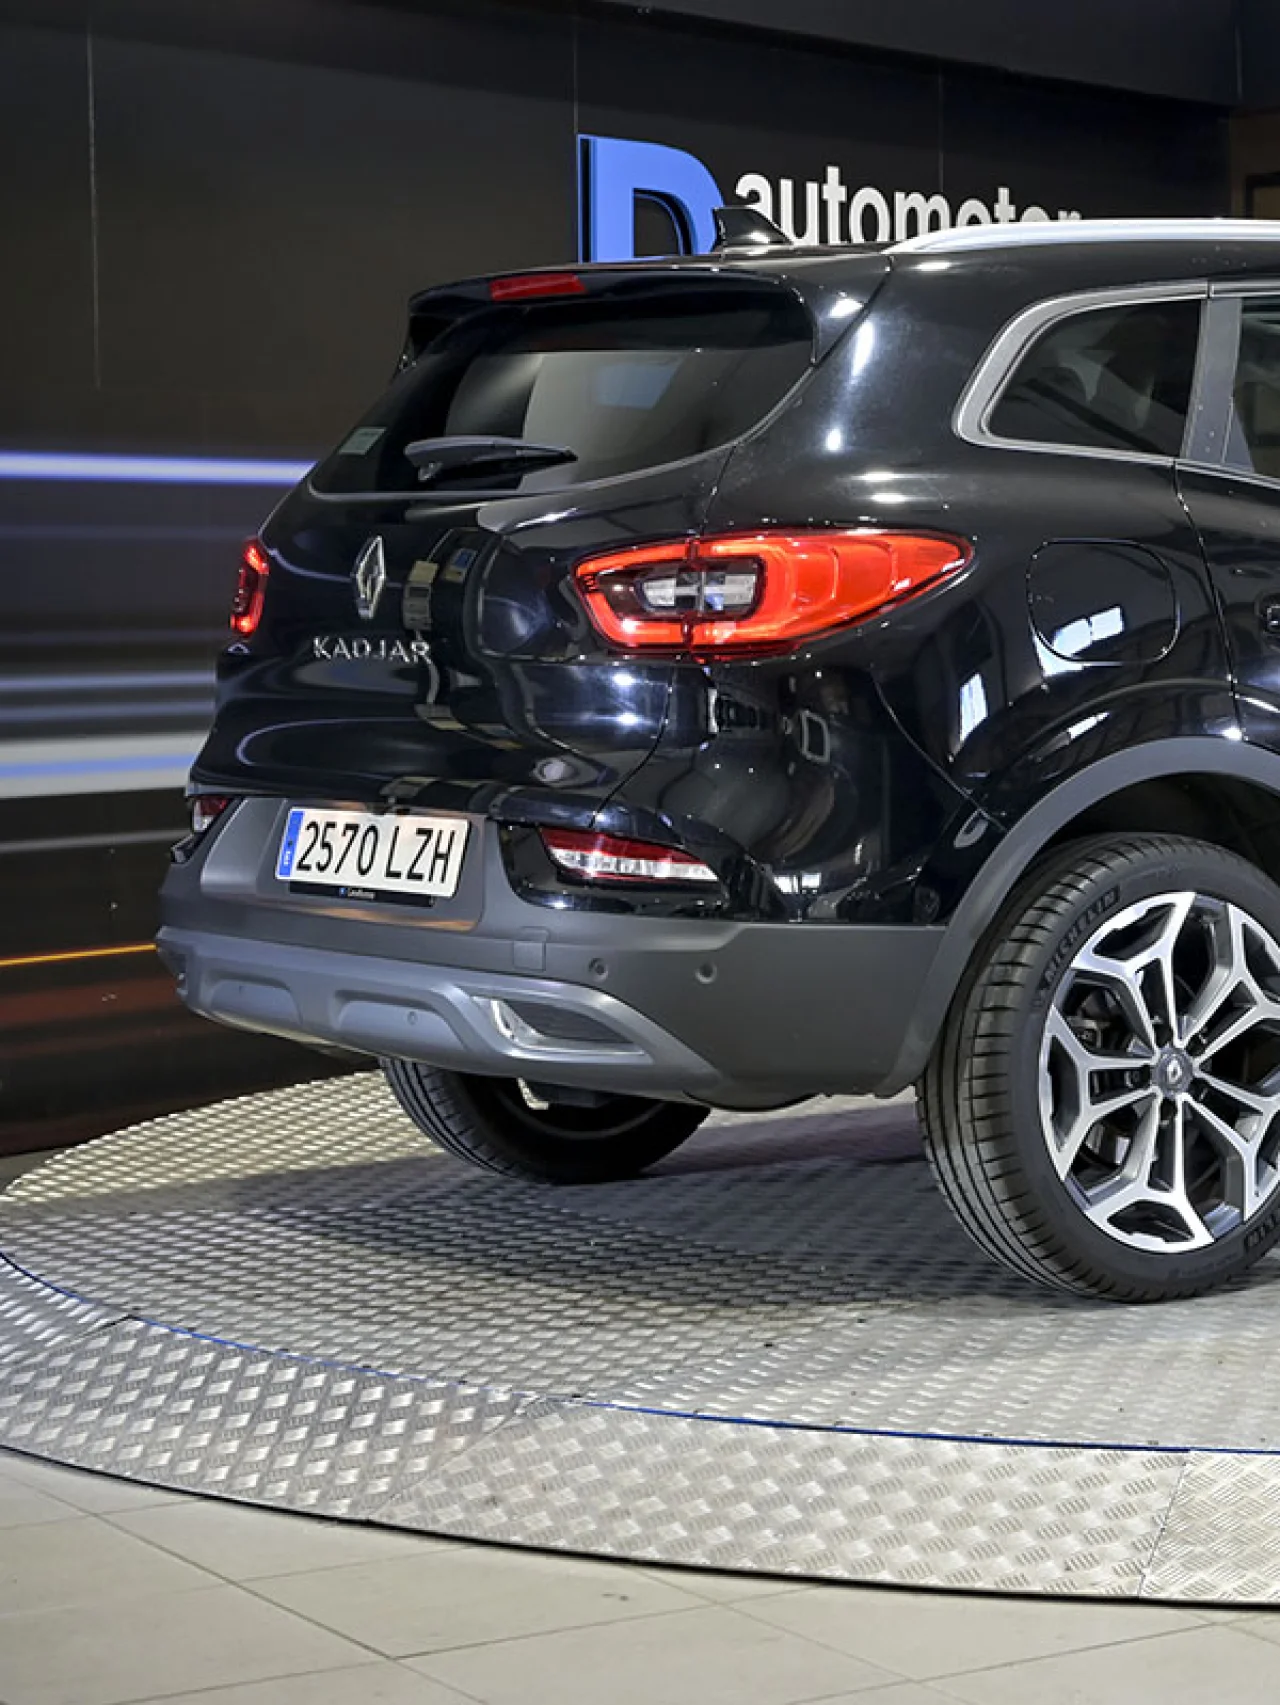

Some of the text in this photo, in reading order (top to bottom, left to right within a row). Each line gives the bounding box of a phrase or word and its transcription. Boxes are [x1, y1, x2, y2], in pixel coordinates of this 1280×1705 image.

[313, 635, 432, 665] KADJAR
[296, 820, 456, 884] 2570 LZH
